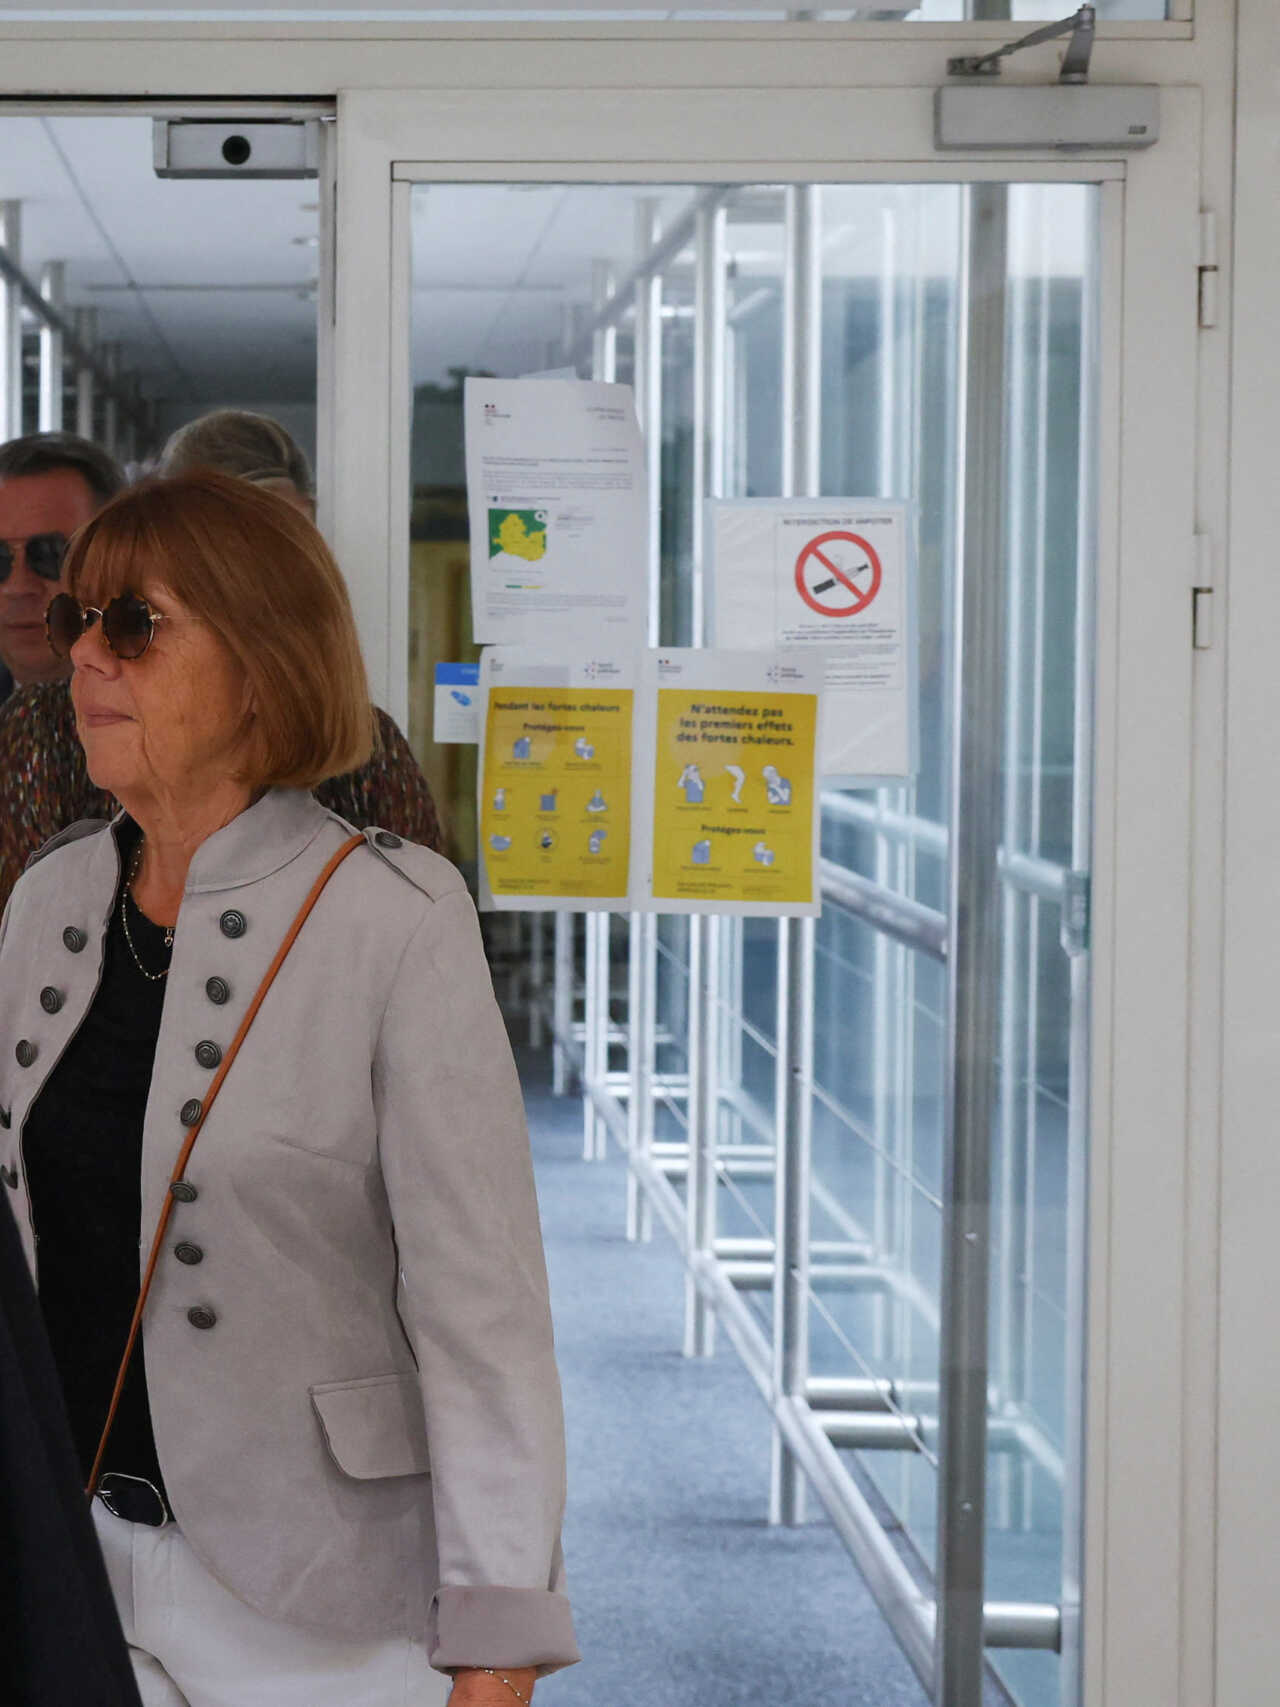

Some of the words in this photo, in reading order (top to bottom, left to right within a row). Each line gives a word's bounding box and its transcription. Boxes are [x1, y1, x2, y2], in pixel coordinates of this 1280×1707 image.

[690, 704, 759, 717] N'attendez
[762, 707, 783, 719] pas
[680, 717, 697, 727] les
[700, 718, 753, 730] premiers
[756, 721, 793, 731] effets
[676, 732, 697, 742] des
[701, 733, 738, 743] fortes
